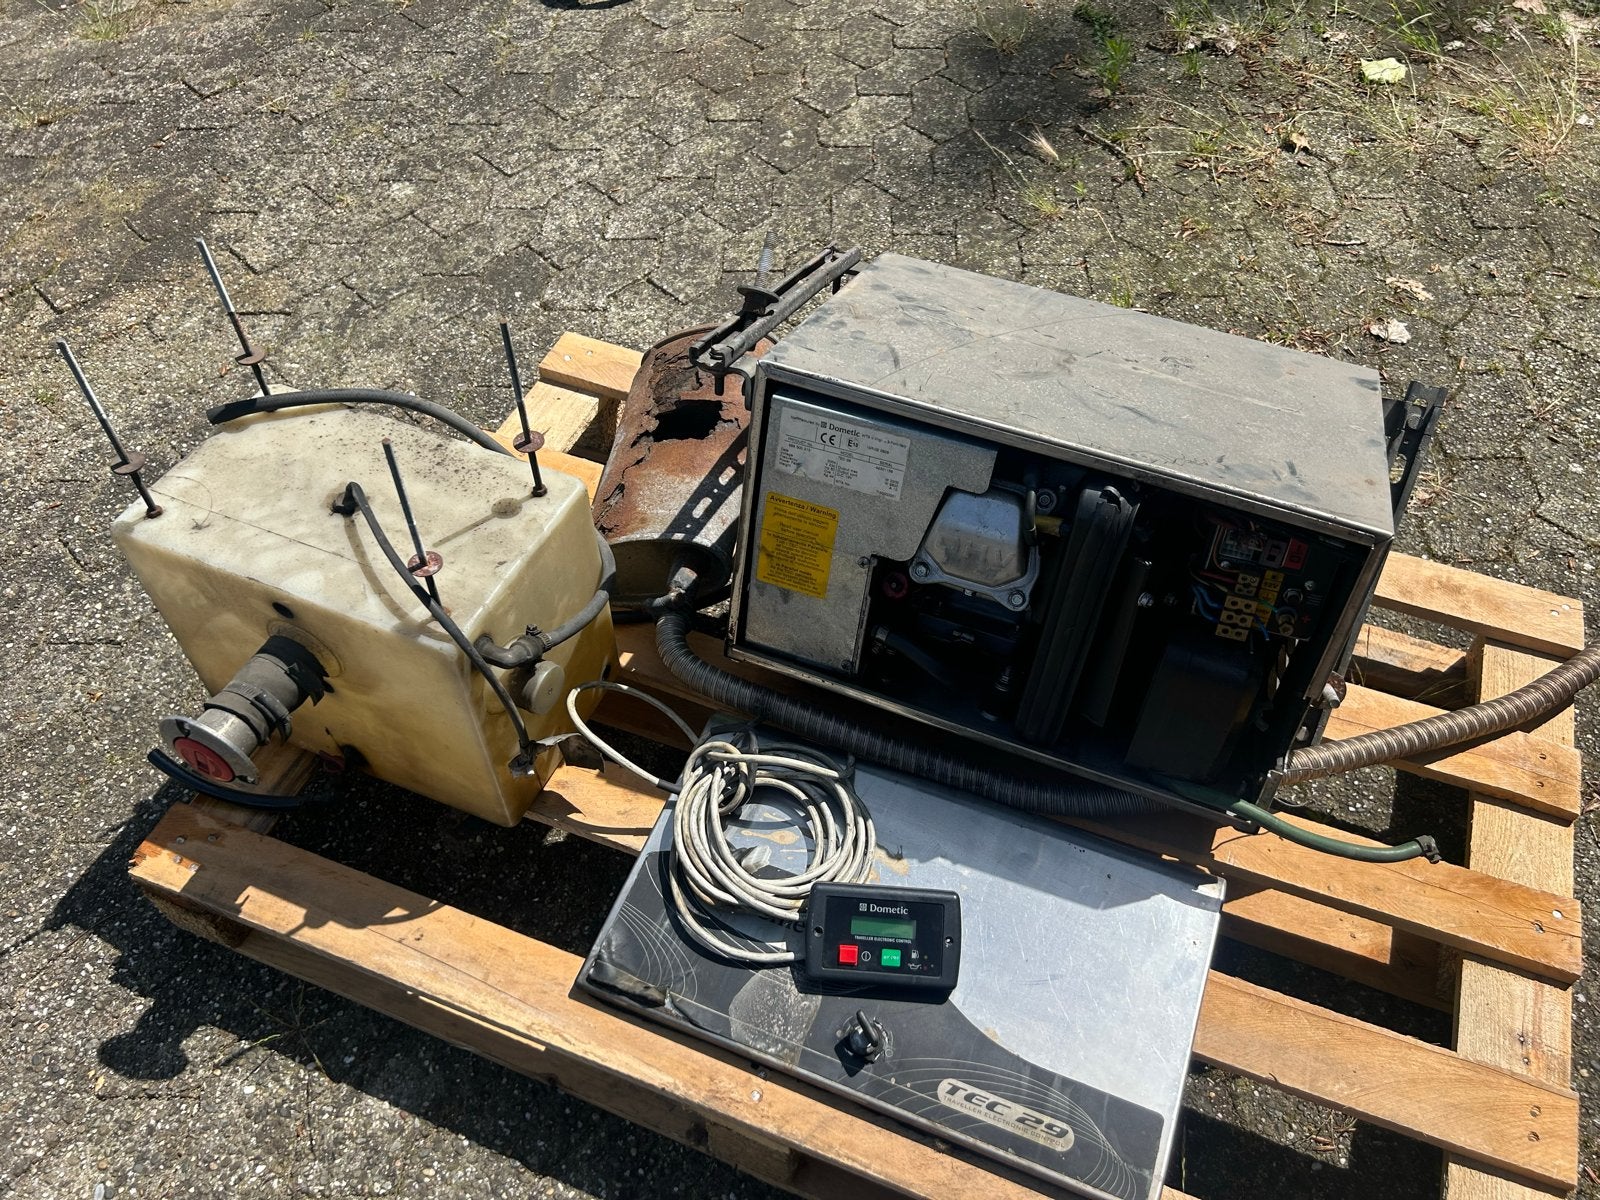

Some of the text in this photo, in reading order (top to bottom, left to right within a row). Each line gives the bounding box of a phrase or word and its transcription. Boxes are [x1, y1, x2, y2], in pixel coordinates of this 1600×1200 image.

[820, 433, 836, 445] CE
[828, 423, 861, 437] Dometic
[770, 495, 805, 509] Avvertenza
[810, 506, 836, 519] Warning
[869, 904, 909, 915] Dometic
[945, 1082, 1068, 1139] TEC 29
[943, 1096, 1065, 1148] TRAVELLER ELECTRONIC CONTROL
